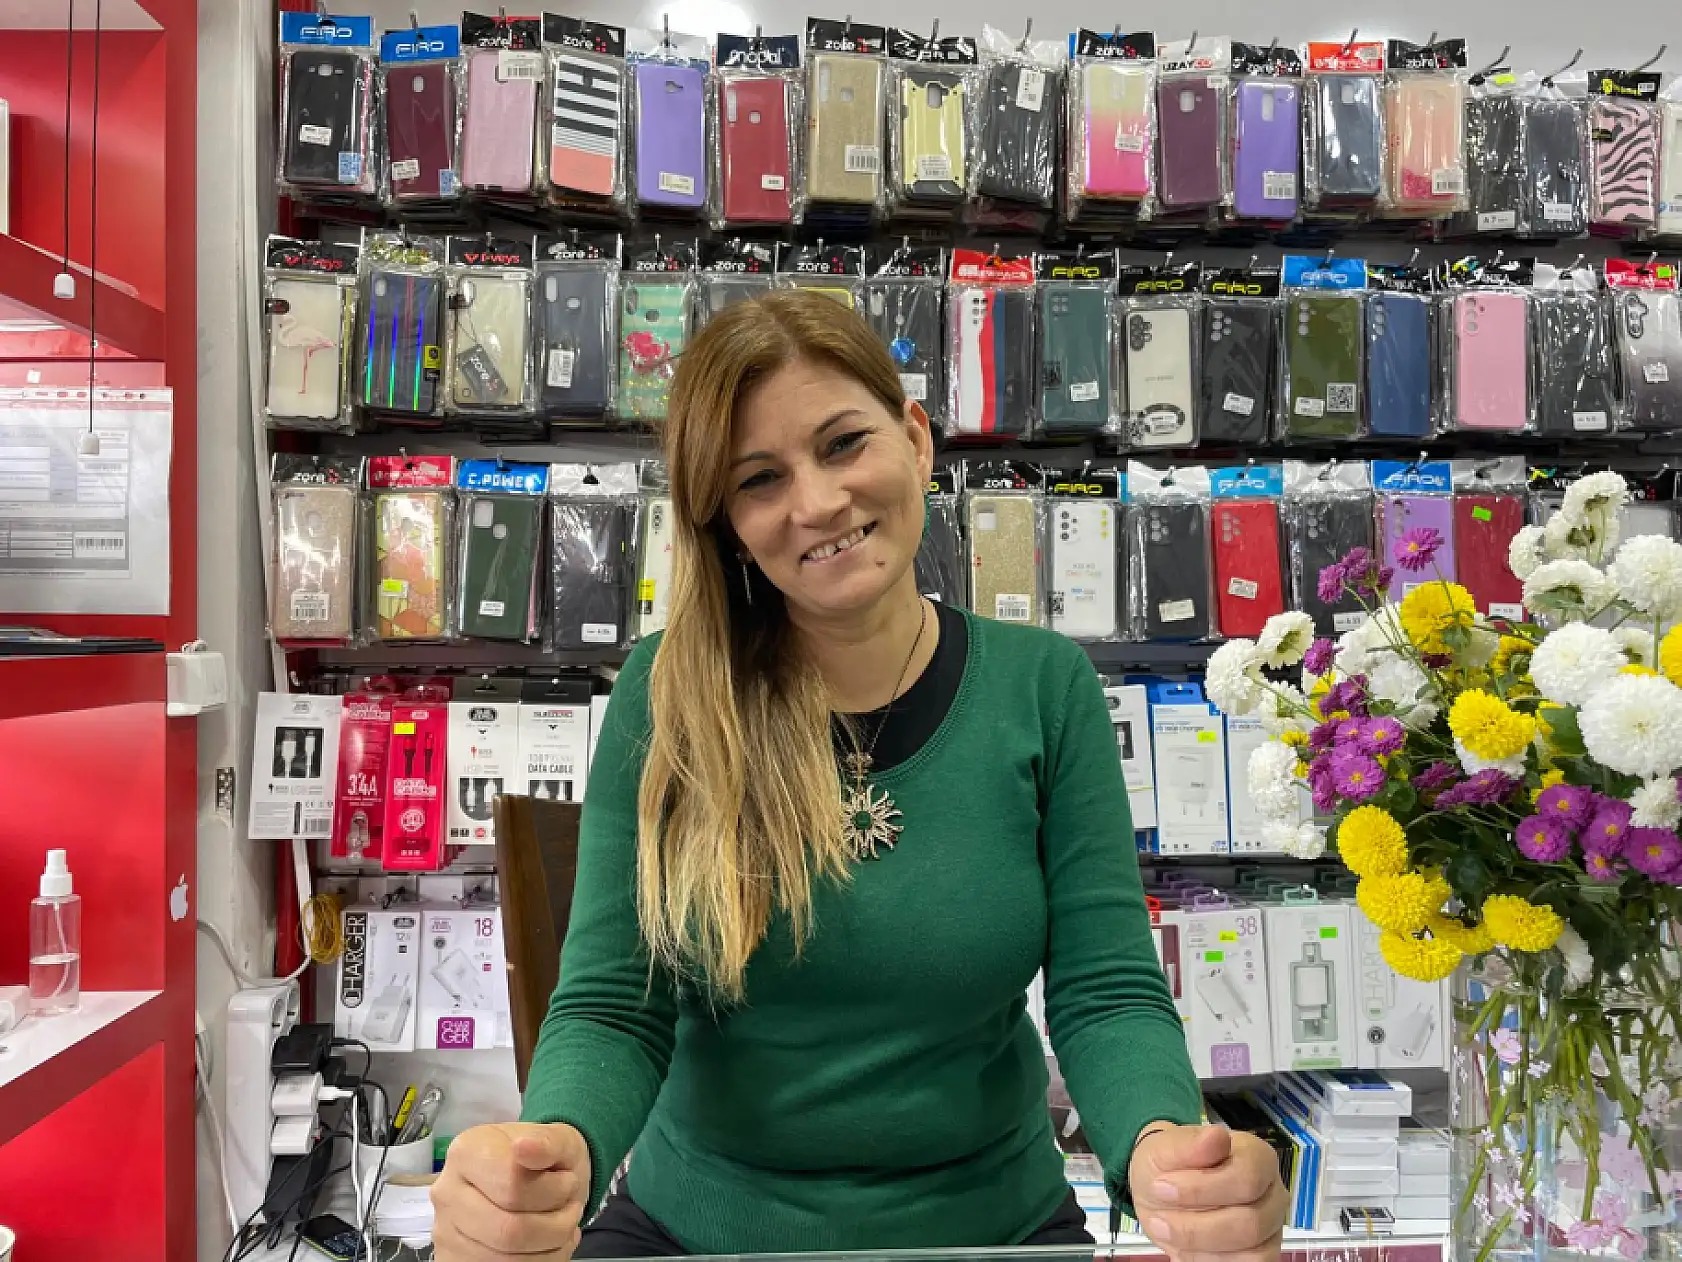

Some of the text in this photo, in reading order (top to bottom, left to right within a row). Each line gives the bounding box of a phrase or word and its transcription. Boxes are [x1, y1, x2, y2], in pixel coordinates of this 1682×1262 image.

[300, 25, 352, 39] FIRO
[395, 42, 444, 57] FIRO
[637, 261, 665, 272] zore
[797, 262, 830, 273] zore
[1052, 266, 1100, 277] FIRO
[1135, 279, 1184, 292] FIRO
[1212, 282, 1262, 295] FIRO
[983, 478, 1012, 488] zore
[1054, 483, 1102, 494] FIRO
[474, 917, 494, 937] 18
[1235, 916, 1258, 937] 38
[342, 915, 365, 999] CHARGER
[1362, 912, 1385, 1009] CHARGE
[441, 1020, 470, 1032] CHAR
[441, 1032, 470, 1043] GER
